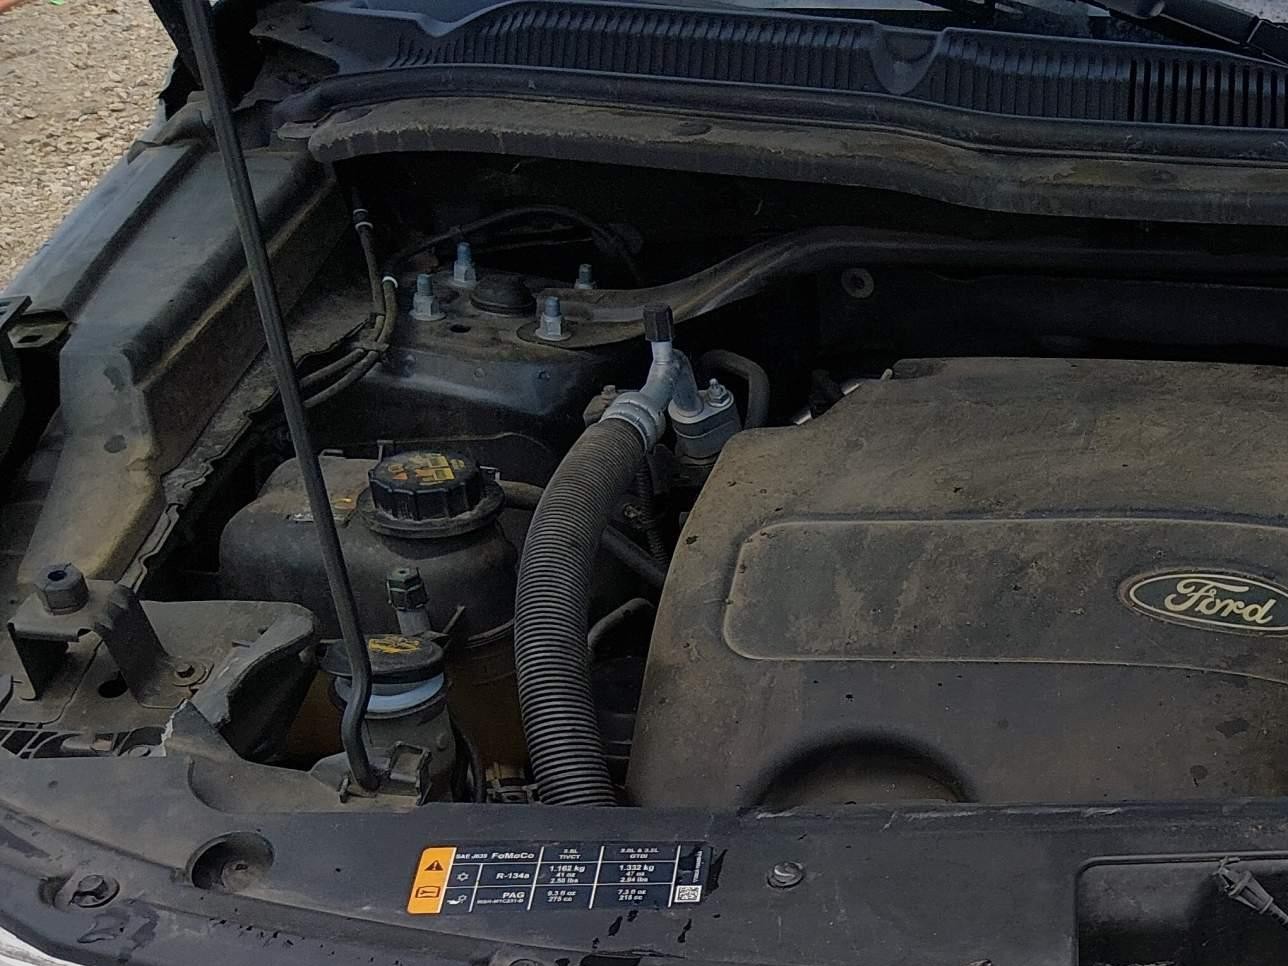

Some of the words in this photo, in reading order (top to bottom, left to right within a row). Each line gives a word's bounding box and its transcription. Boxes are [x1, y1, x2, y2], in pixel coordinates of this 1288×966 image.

[1164, 578, 1277, 624] Ford
[491, 852, 535, 860] FoMoCo
[574, 865, 586, 873] kg
[643, 864, 655, 872] kg
[496, 872, 530, 880] R-134a
